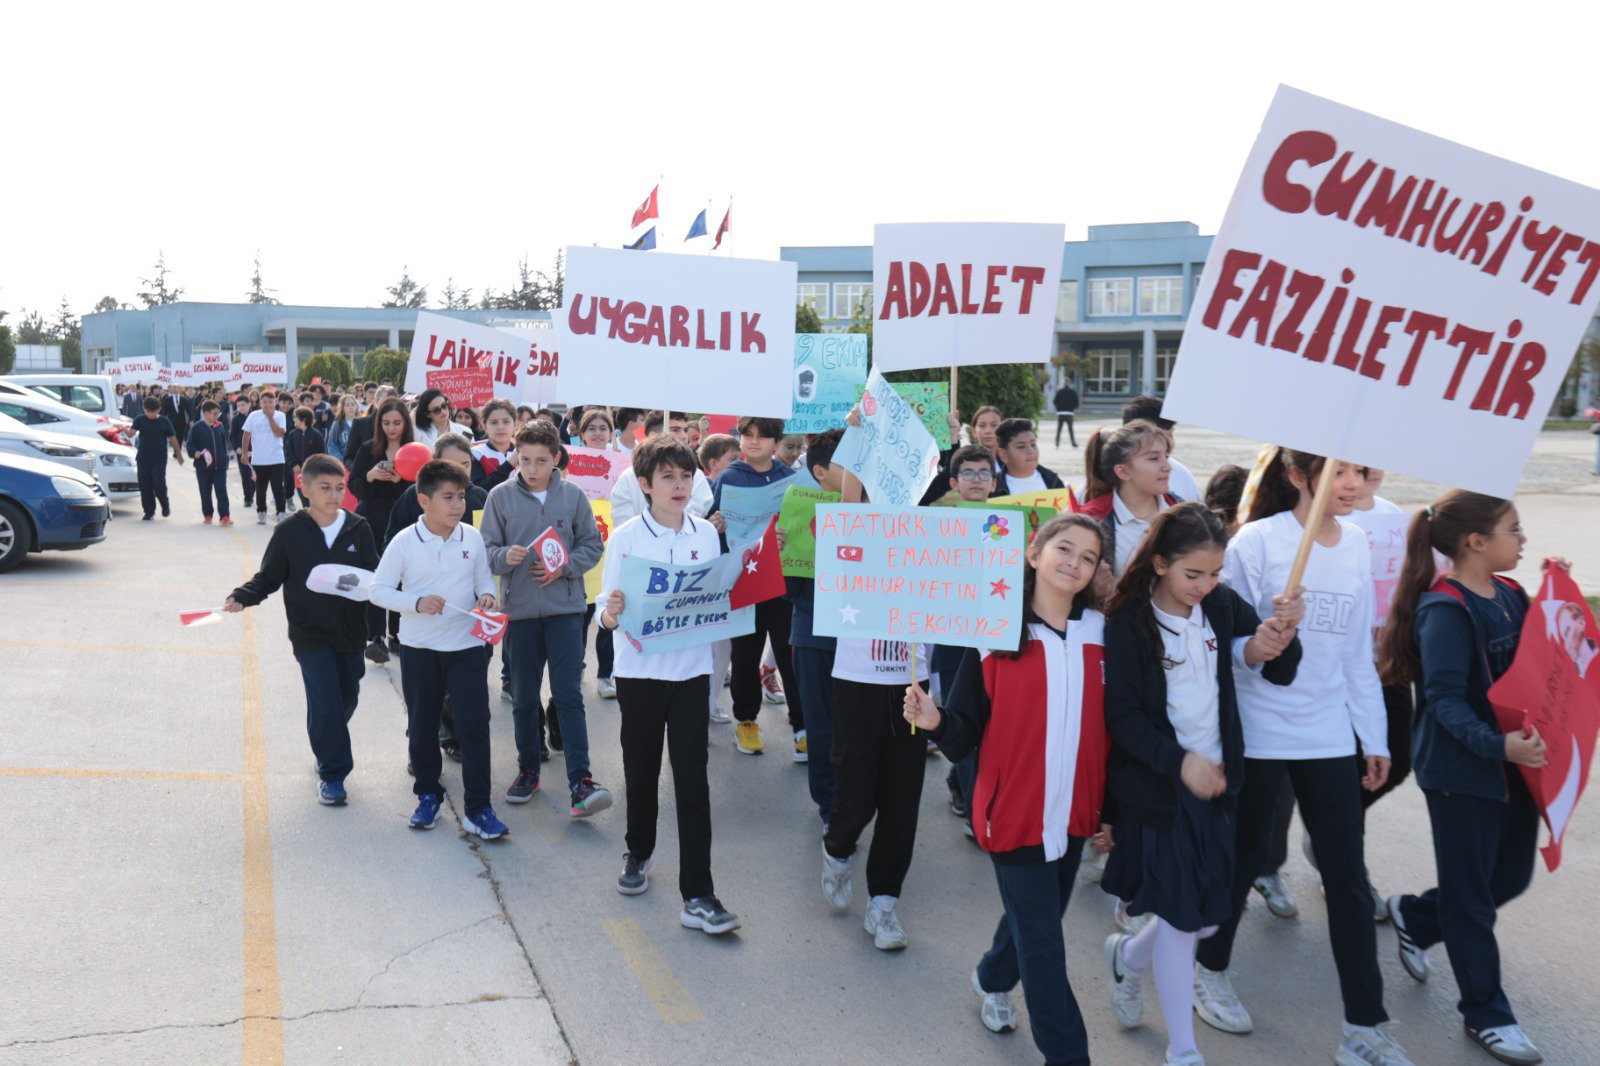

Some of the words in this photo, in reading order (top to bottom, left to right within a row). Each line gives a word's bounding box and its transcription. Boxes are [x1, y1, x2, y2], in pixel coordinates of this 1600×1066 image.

[1263, 130, 1600, 305] CUMHURİYET
[878, 261, 1046, 320] ADALET
[568, 293, 766, 354] UYGARLIK
[1202, 248, 1547, 420] FAZİLETTİR
[425, 334, 520, 388] LAİKİK
[463, 550, 470, 559] K
[691, 550, 699, 560] K
[641, 615, 690, 636] BÖYLE
[874, 664, 908, 673] TÜRKİYE
